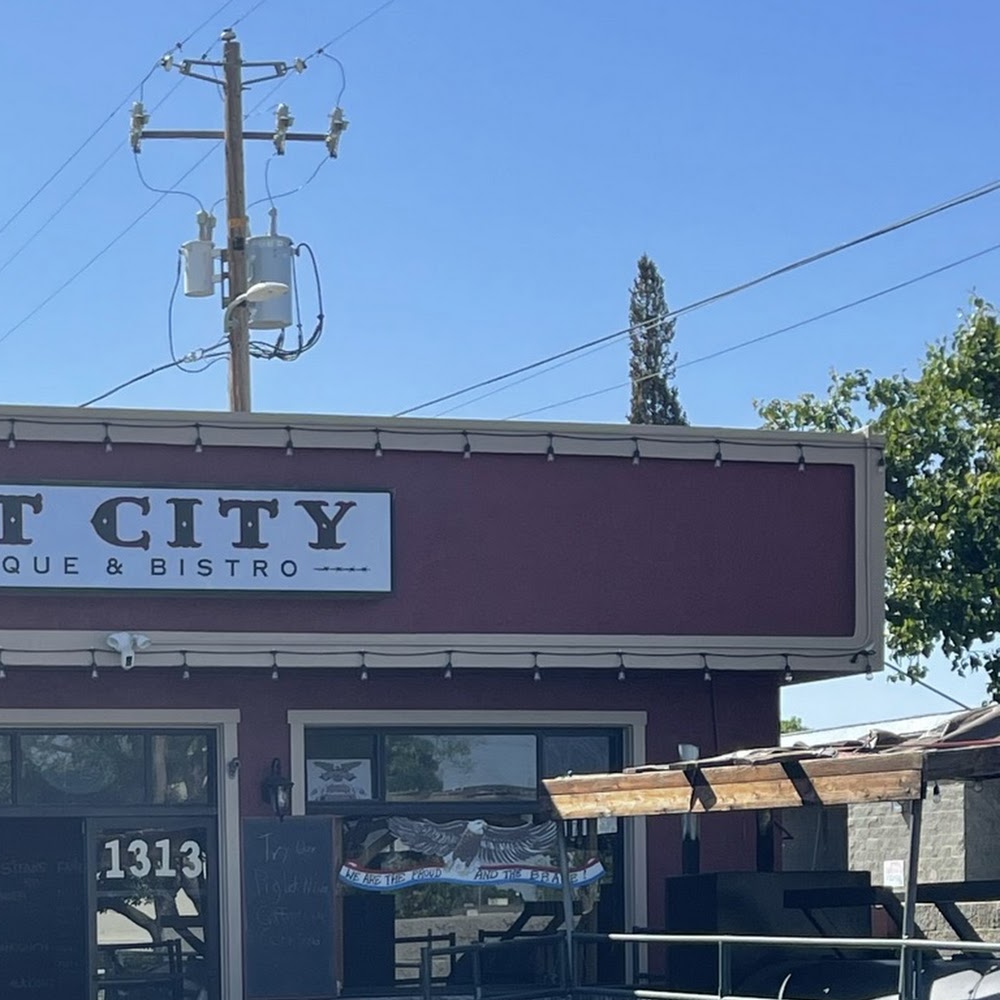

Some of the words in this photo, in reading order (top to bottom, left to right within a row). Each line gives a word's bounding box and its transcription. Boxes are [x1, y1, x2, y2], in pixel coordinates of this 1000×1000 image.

[90, 496, 357, 551] CITY
[106, 558, 123, 575] &
[151, 558, 297, 577] BISTRO
[105, 839, 203, 878] 1313
[345, 868, 360, 881] WE
[362, 873, 382, 885] ARE
[385, 873, 406, 885] THE
[411, 868, 443, 881] PROUD
[474, 868, 499, 880] AND
[500, 869, 522, 880] THE
[529, 869, 588, 884] BRAE!
